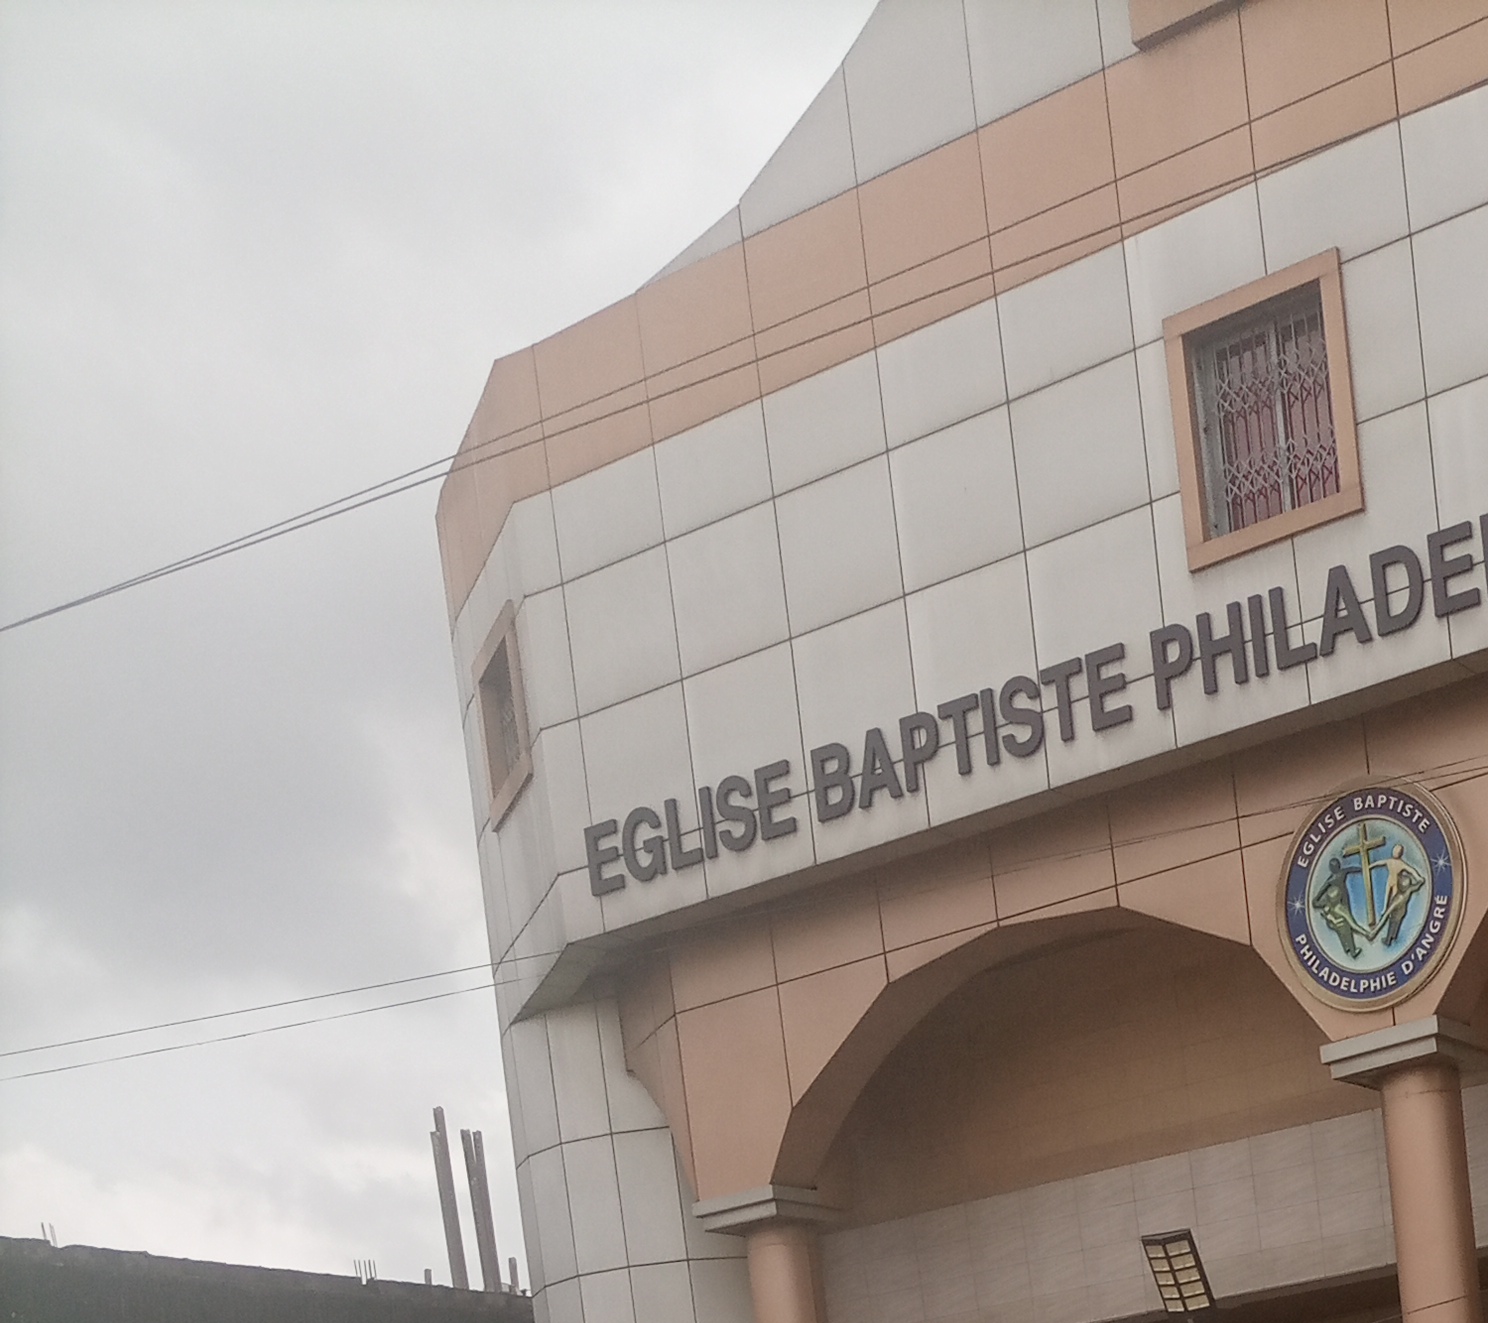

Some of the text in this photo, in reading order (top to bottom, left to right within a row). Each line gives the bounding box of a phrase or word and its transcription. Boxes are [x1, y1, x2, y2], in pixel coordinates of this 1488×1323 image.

[583, 758, 797, 898] EGLISE
[810, 642, 1132, 825] BAPTISTE
[1297, 794, 1431, 868] EGLISE BAPTISTE
[1295, 894, 1449, 994] PHILADELPHIE D'ANGRÉ
